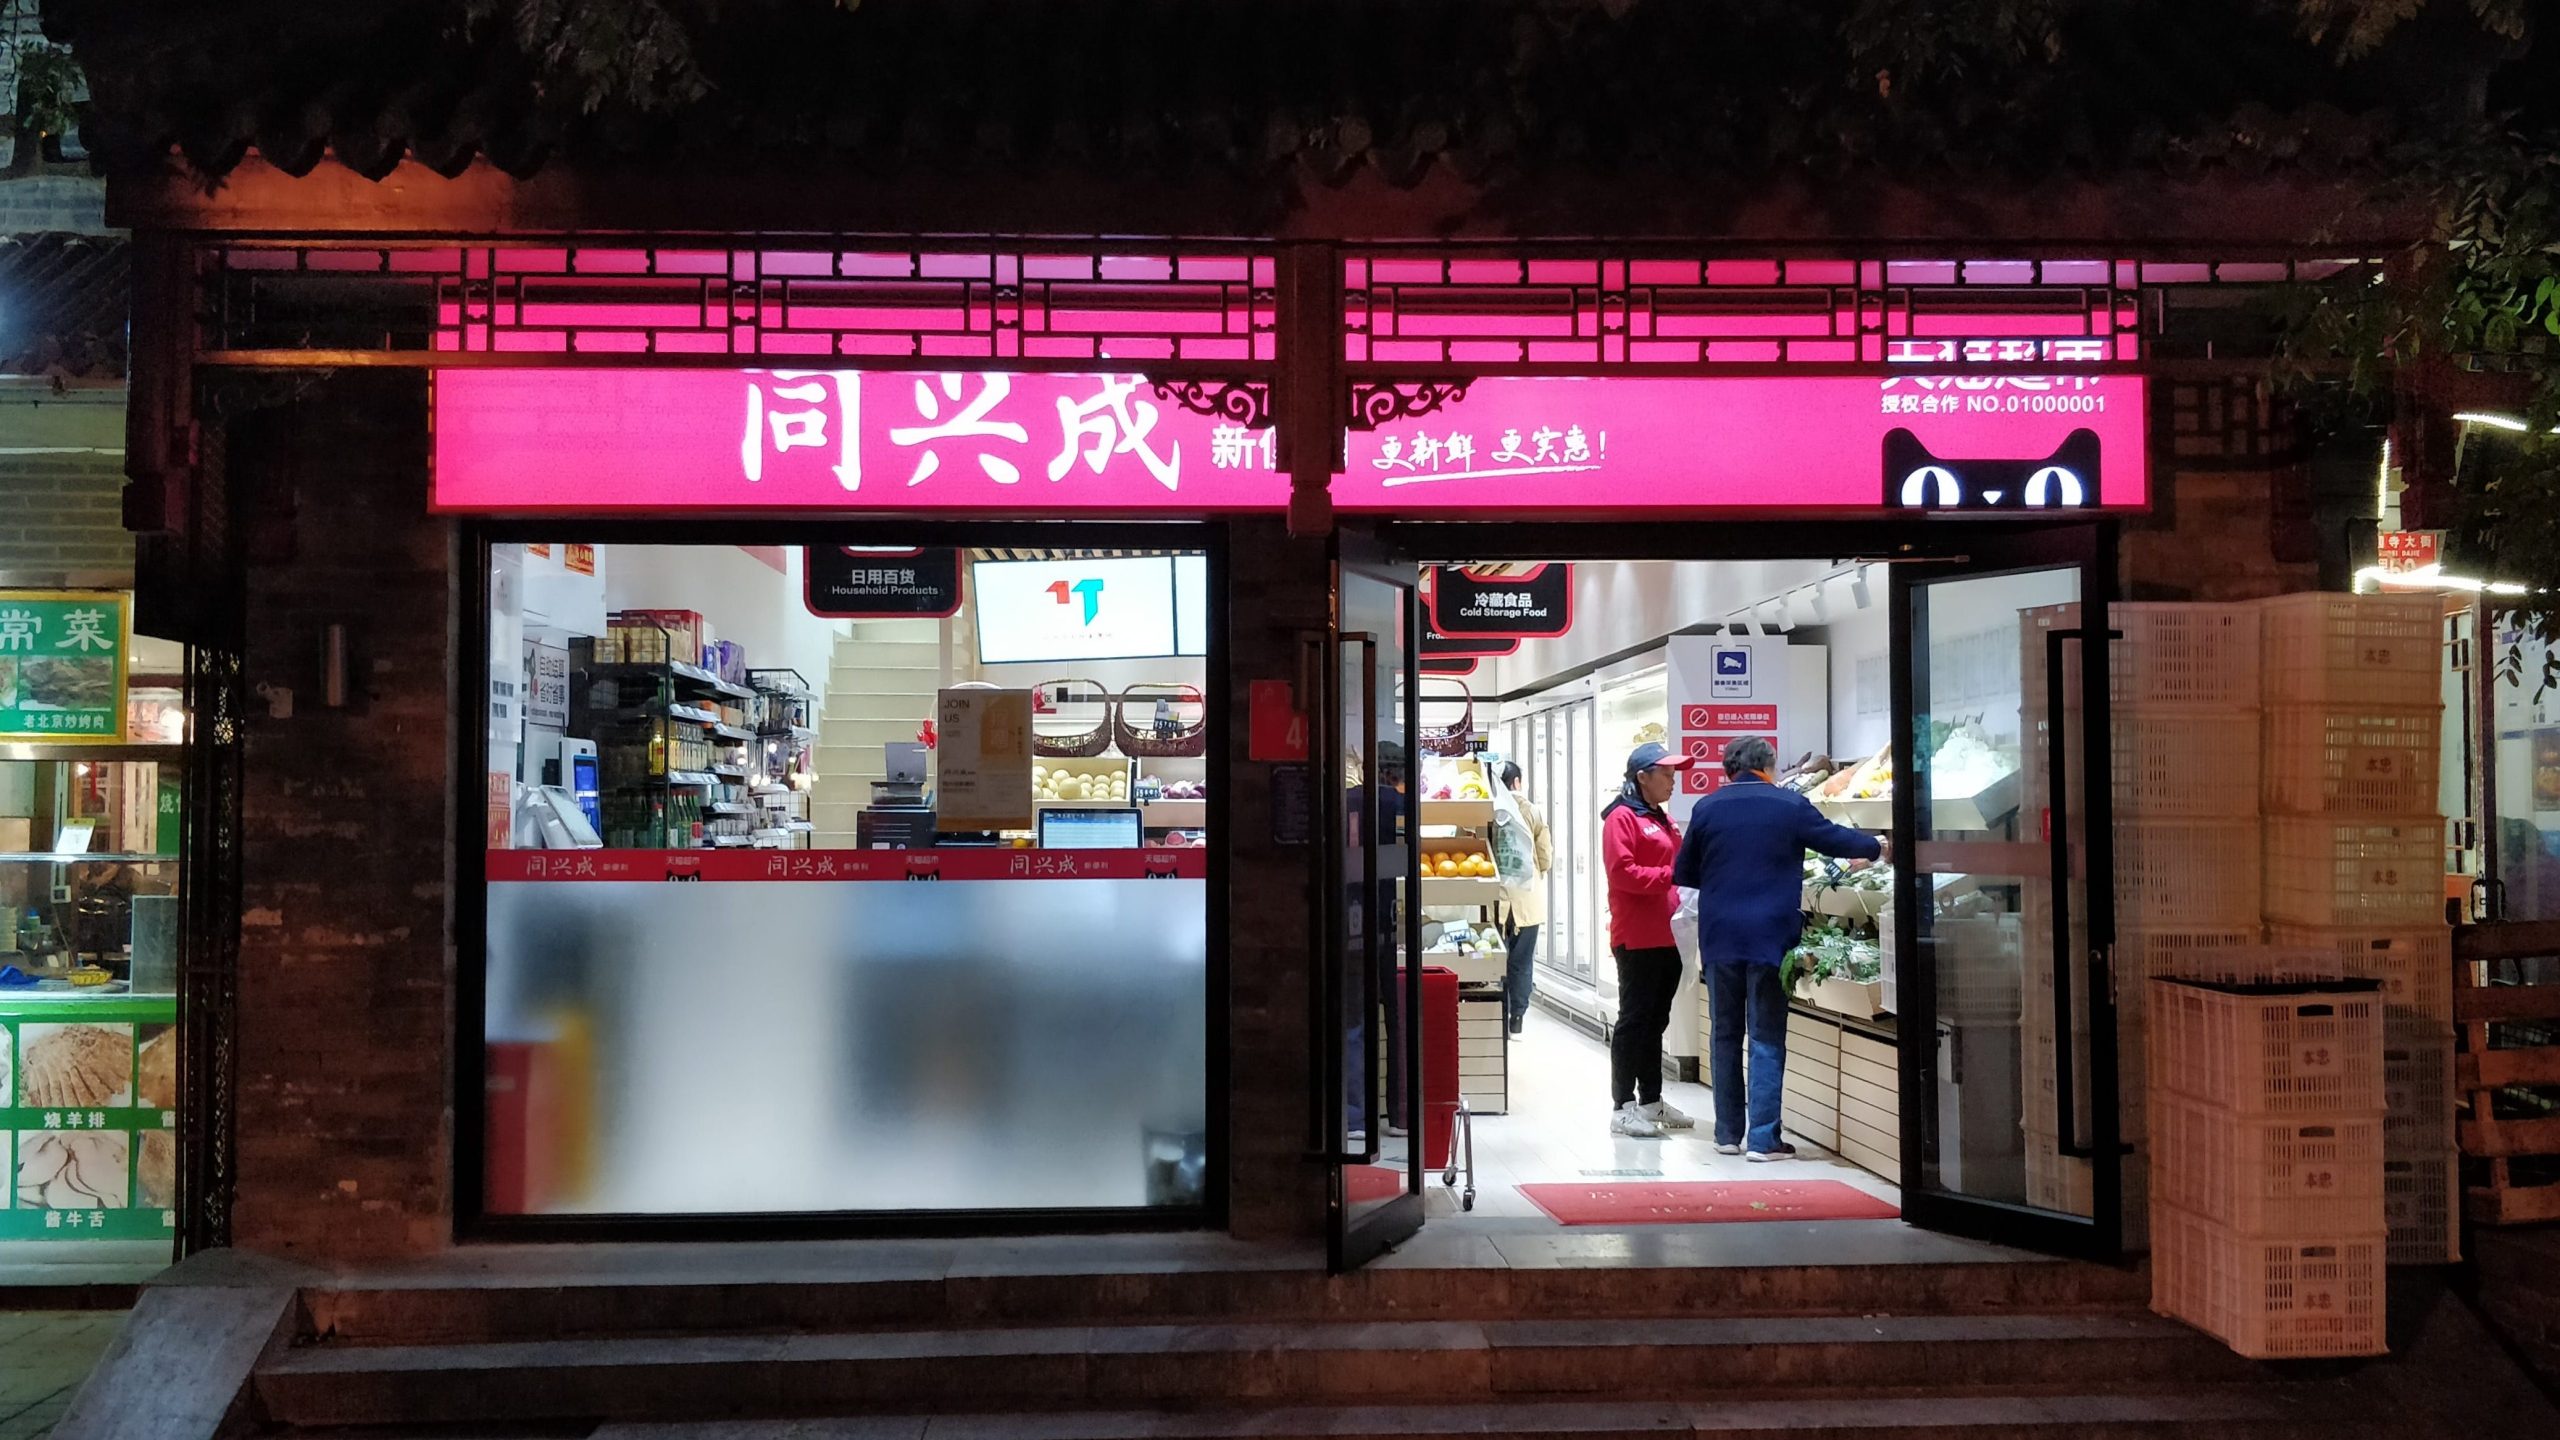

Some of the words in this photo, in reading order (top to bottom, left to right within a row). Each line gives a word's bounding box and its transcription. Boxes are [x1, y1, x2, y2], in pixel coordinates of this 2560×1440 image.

[1881, 394, 1960, 413] 授权合作
[1967, 394, 2105, 413] NO.01000001
[741, 368, 1180, 491] 同兴成
[1372, 430, 1476, 471] 更新鲜
[852, 569, 915, 585] 日用百货
[832, 585, 888, 595] Household
[891, 585, 939, 595] Products
[1475, 592, 1532, 608] 冷藏食品
[1460, 607, 1482, 617] Cold
[1484, 607, 1521, 618] Storage
[1523, 607, 1547, 617] Food
[944, 699, 970, 709] JOIN
[944, 714, 960, 723] US
[526, 855, 596, 877] 同兴成
[767, 855, 837, 876] 同兴成
[1009, 854, 1078, 875] 同兴成
[44, 1111, 105, 1128] 烧羊排
[45, 1211, 105, 1228] 酱牛舌
